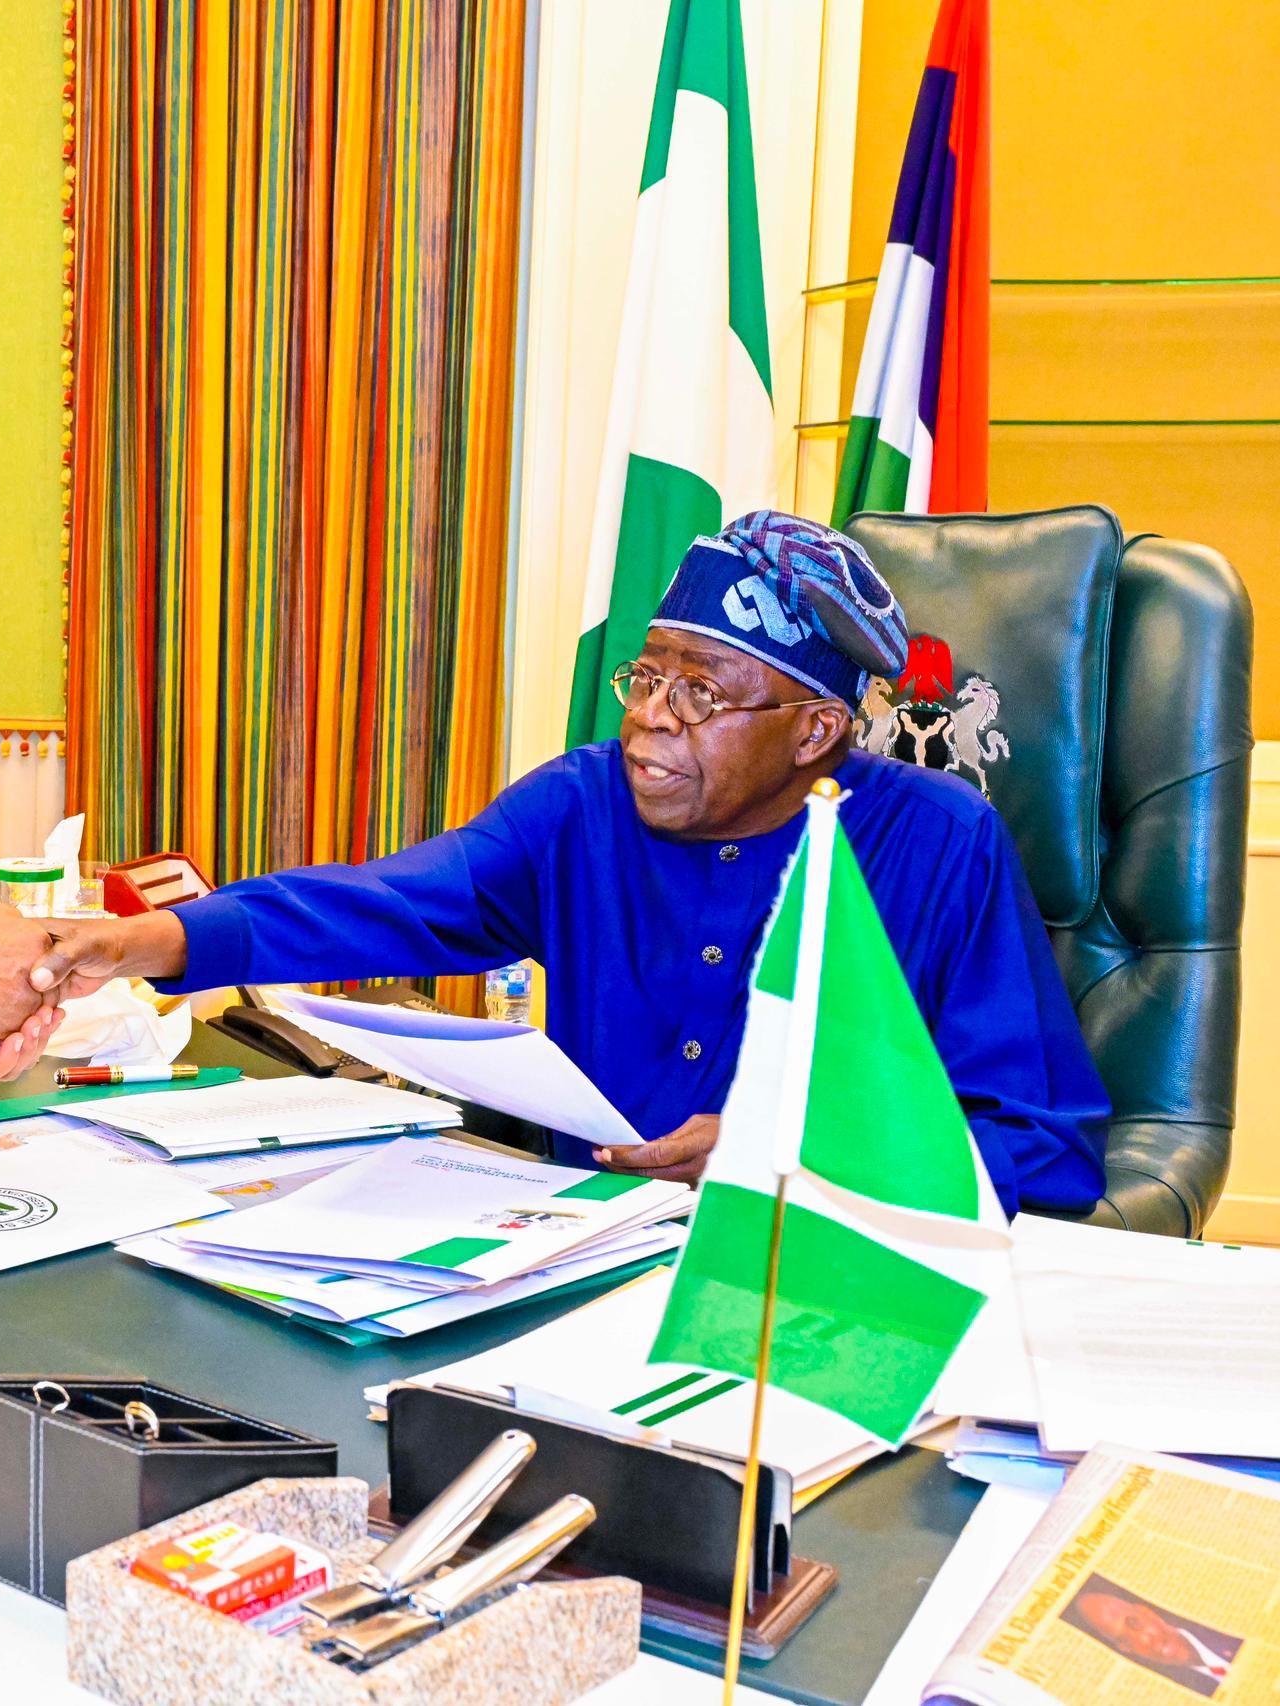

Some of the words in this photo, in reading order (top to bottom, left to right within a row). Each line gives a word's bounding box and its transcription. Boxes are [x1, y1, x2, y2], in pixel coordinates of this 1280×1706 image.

[20, 1214, 45, 1225] THE
[1107, 1465, 1154, 1512] Foresight
[1102, 1504, 1121, 1524] of
[1075, 1518, 1115, 1550] Power
[1059, 1545, 1092, 1569] The
[1050, 1564, 1077, 1589] and
